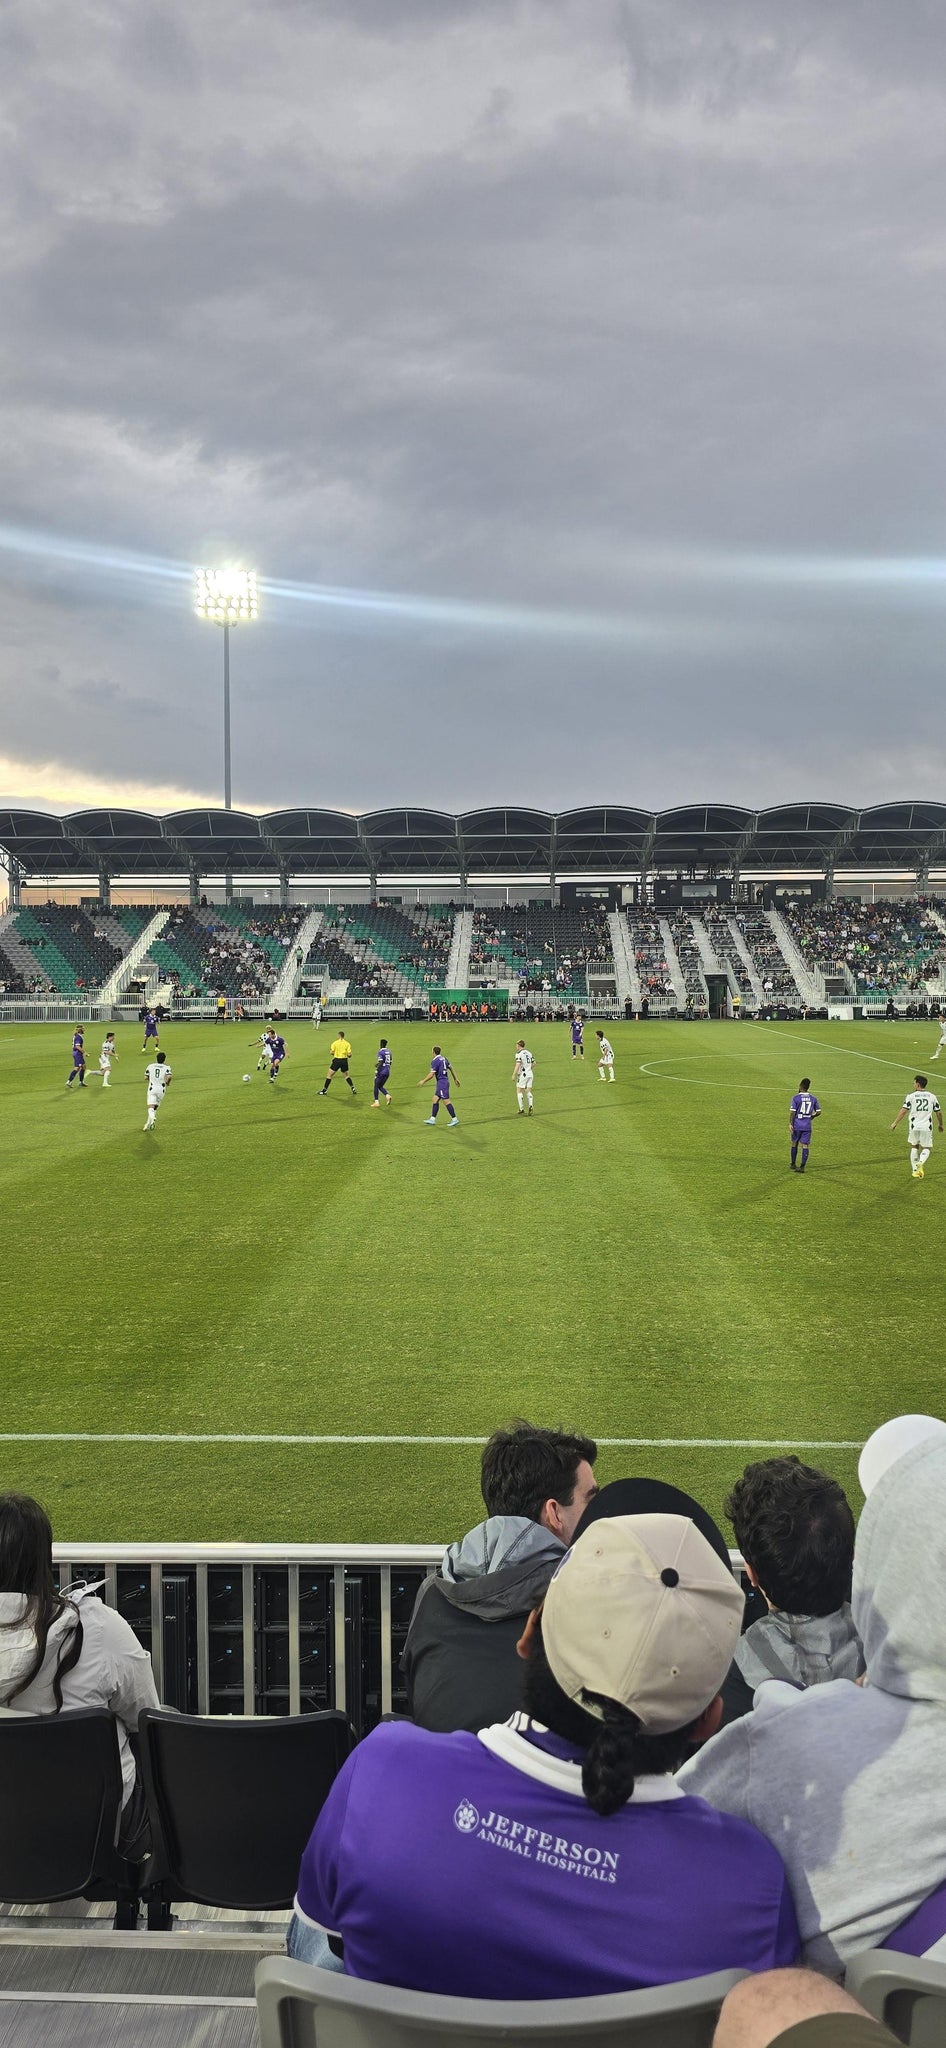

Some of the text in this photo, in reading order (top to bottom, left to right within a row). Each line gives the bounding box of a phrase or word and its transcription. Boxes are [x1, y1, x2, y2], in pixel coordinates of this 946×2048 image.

[155, 1068, 160, 1078] 8
[800, 1101, 812, 1114] 47
[916, 1098, 929, 1112] 22
[481, 1811, 619, 1869] JEFFERSON
[477, 1828, 617, 1884] ANIMAL HOSPITALS
